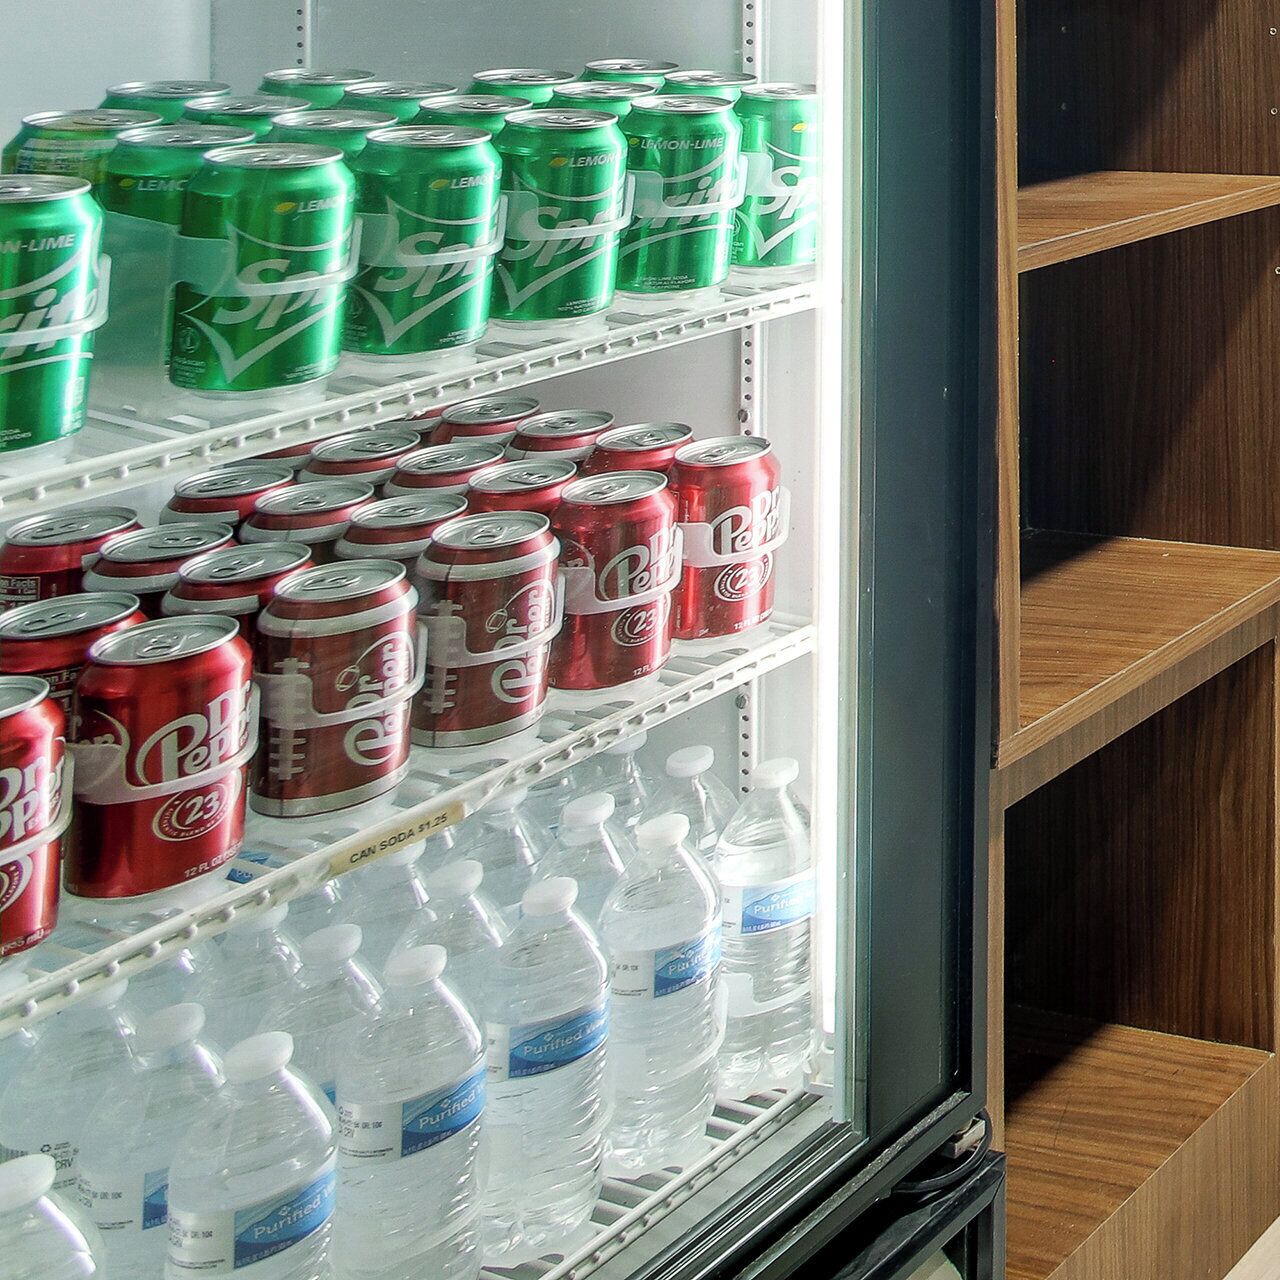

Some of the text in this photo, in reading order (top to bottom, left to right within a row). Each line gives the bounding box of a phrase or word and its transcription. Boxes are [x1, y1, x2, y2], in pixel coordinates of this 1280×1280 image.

[640, 137, 724, 150] LEMON-LIME
[737, 565, 759, 588] 23
[633, 608, 658, 634] 23
[208, 679, 250, 739] Dr
[185, 790, 221, 826] 23
[350, 812, 448, 865] CAN SODA $1.25
[184, 867, 199, 877] 12
[753, 895, 801, 915] Purified
[523, 1032, 583, 1057] Purified
[419, 1092, 476, 1129] Purified
[254, 1198, 321, 1239] Purified
